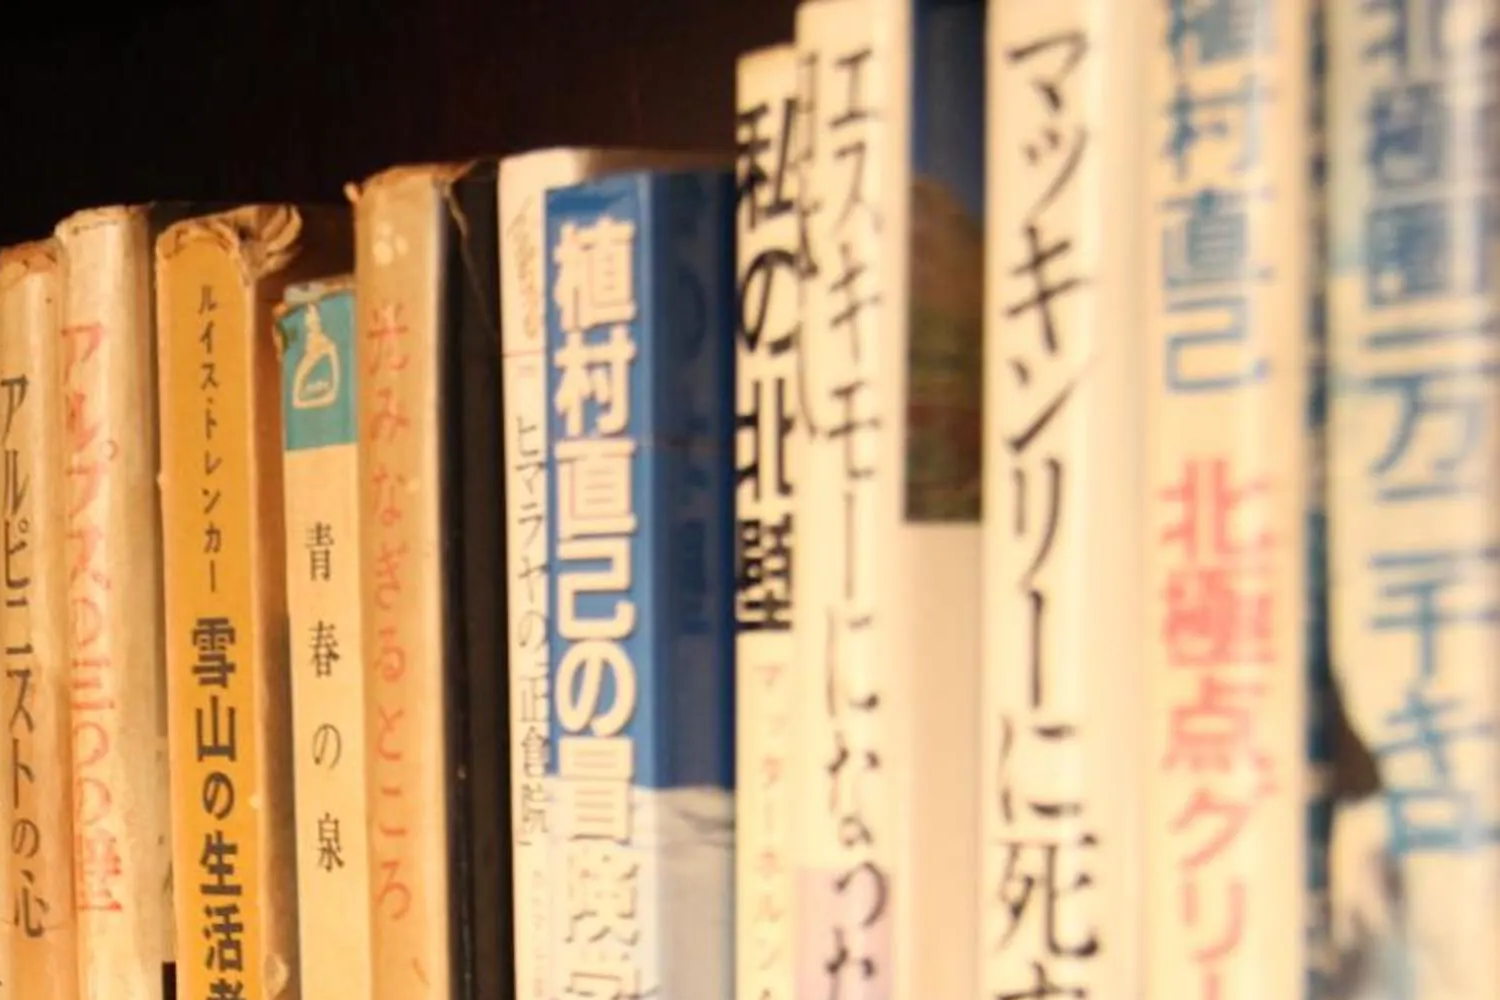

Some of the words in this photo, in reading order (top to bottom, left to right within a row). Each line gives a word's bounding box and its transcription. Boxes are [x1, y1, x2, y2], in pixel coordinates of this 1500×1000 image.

[736, 98, 798, 632] 私の北壁
[0, 374, 50, 939] アルピニストの心
[304, 521, 347, 873] 青春の泉
